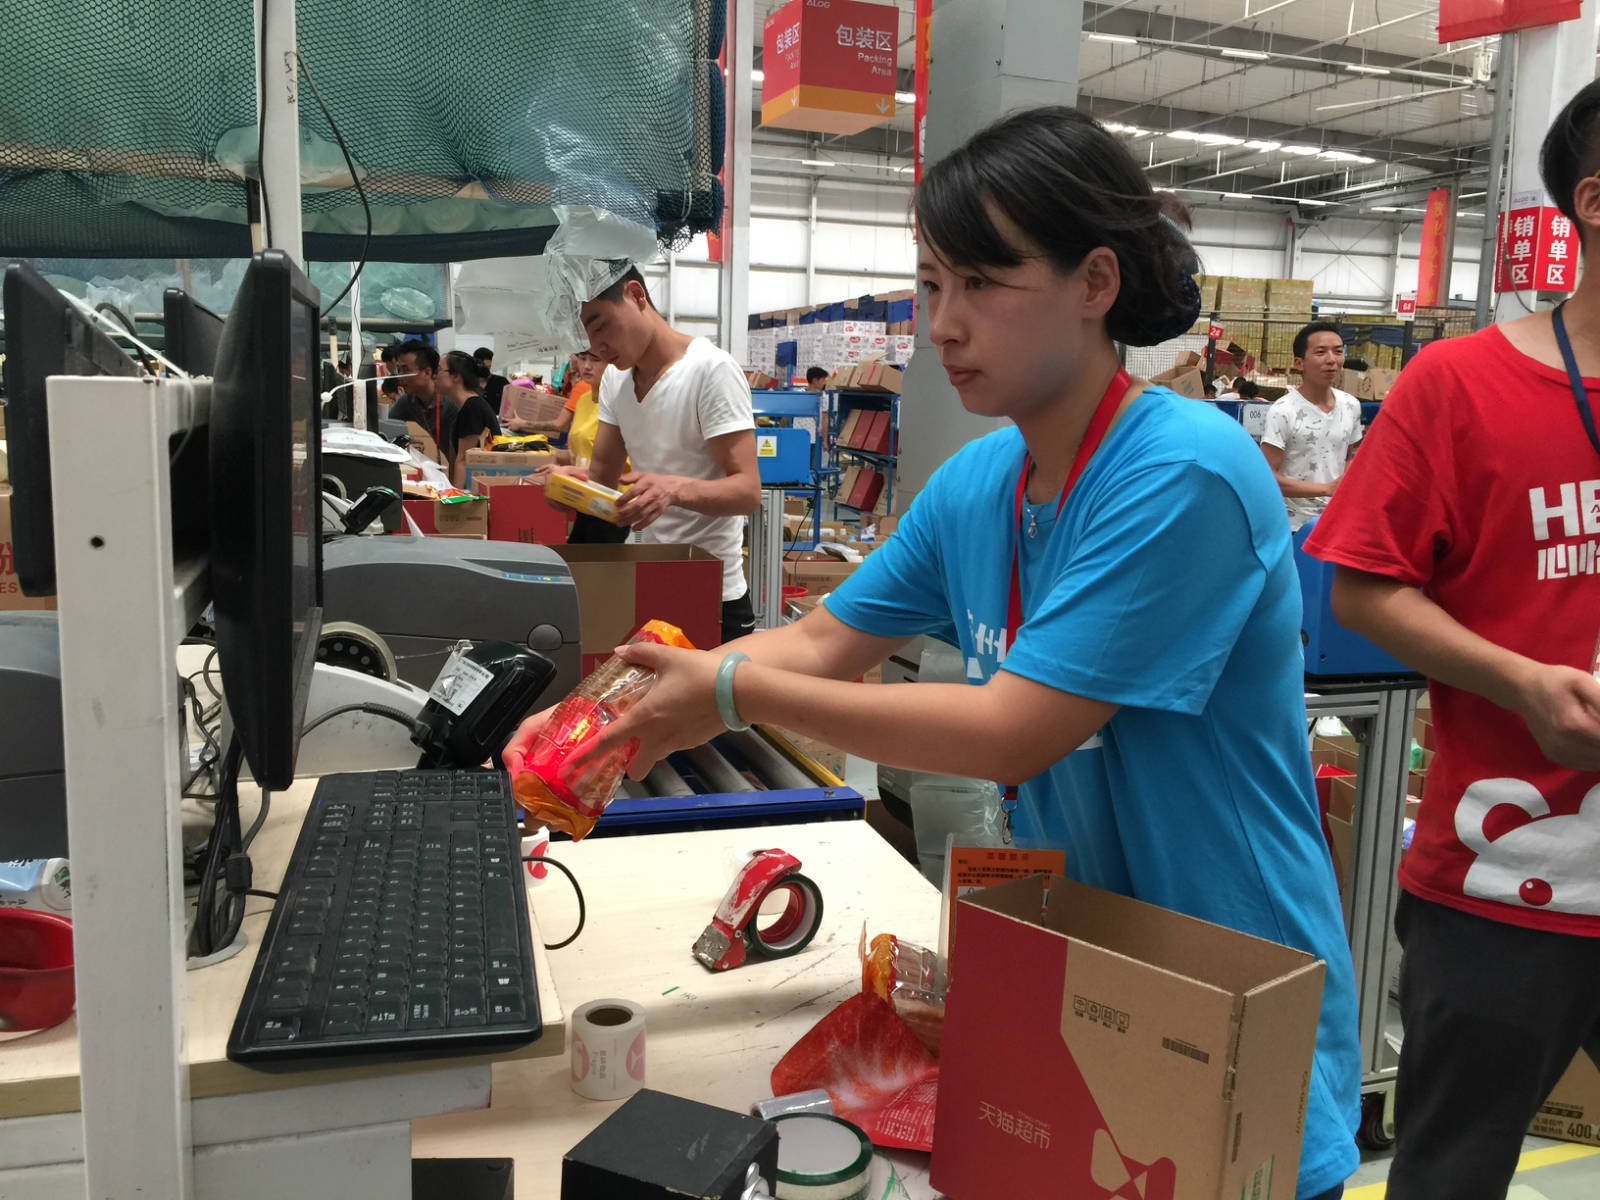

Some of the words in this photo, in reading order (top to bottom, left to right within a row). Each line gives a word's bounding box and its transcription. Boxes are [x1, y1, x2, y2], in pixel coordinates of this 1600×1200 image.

[836, 24, 893, 51] 包装区
[857, 52, 893, 66] Packing
[872, 65, 892, 77] Area
[1511, 215, 1535, 284] 销单区
[1546, 215, 1571, 285] 销单区
[979, 1100, 1051, 1149] 天猫超市
[1566, 1122, 1592, 1139] 400
